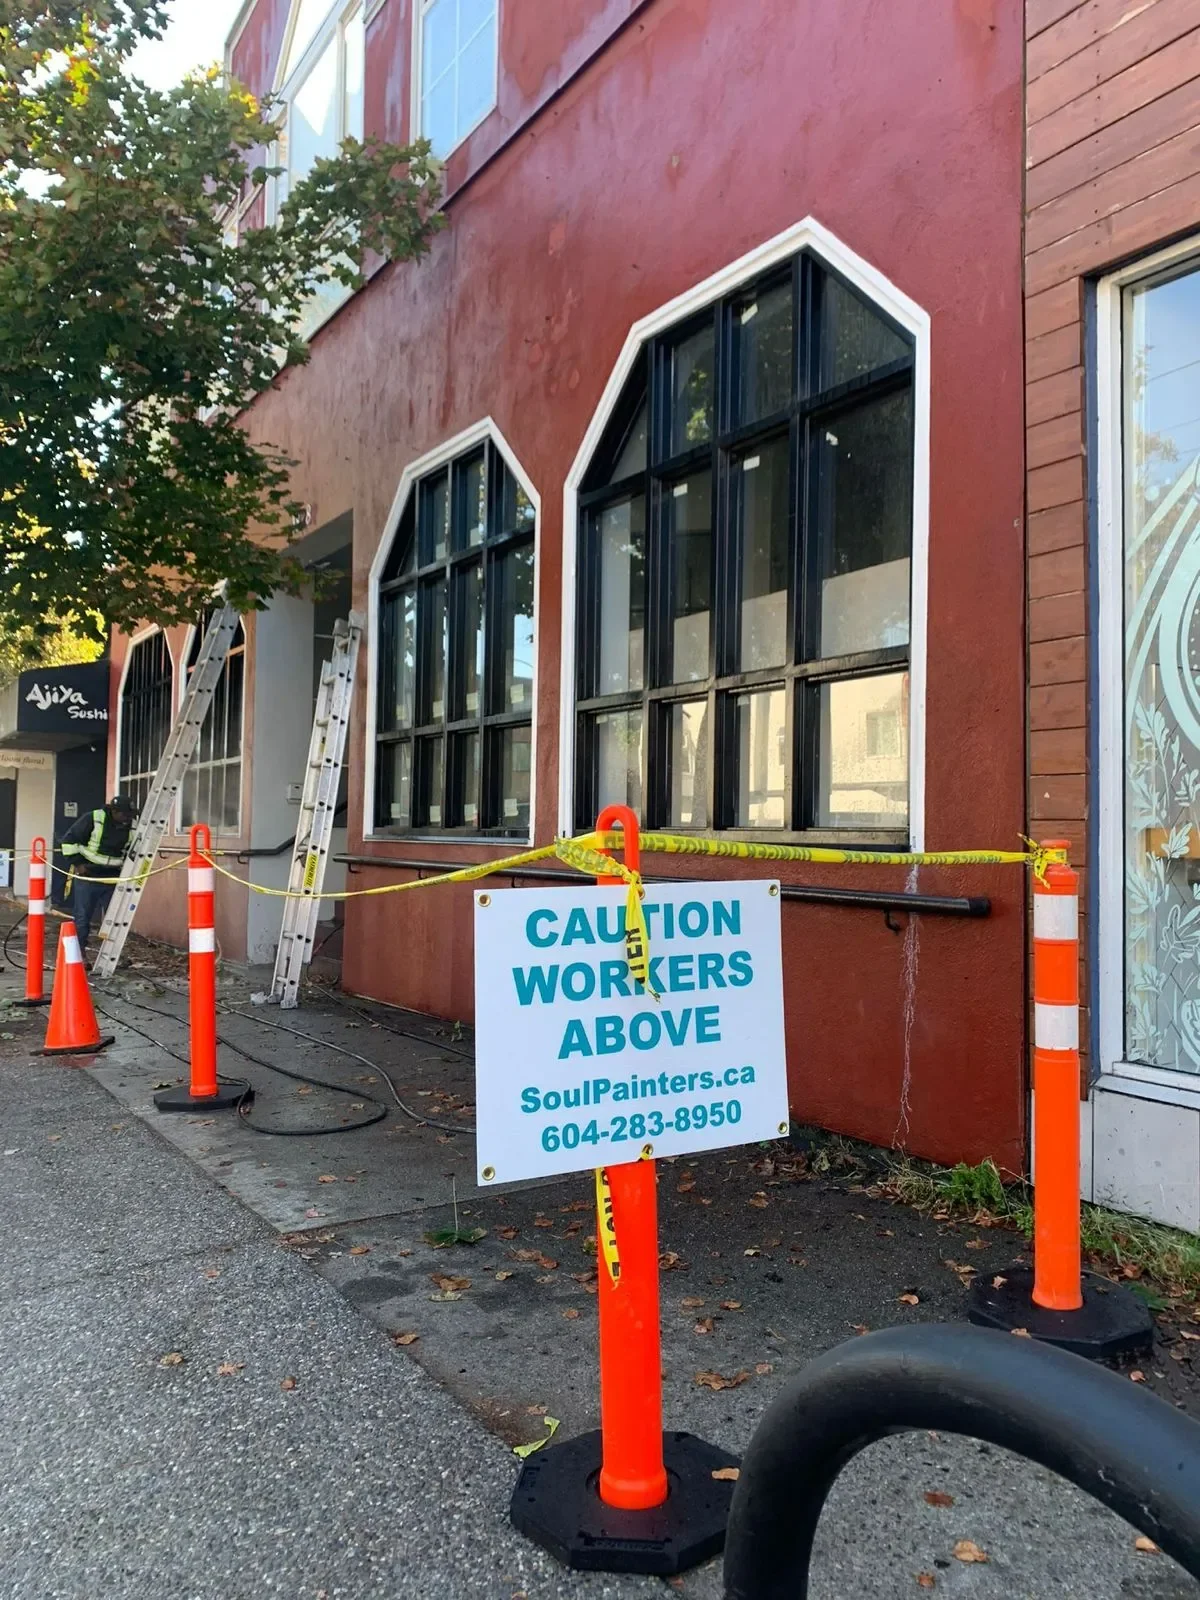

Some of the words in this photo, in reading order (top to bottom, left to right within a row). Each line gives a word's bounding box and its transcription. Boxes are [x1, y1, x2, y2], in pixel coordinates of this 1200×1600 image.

[67, 705, 108, 720] Sushi
[525, 899, 742, 949] CAUTION
[512, 950, 754, 1006] WORKERS
[557, 1005, 722, 1060] ABOVE
[520, 1065, 756, 1114] SoulPainters.ca
[540, 1099, 743, 1153] 604-283-8950
